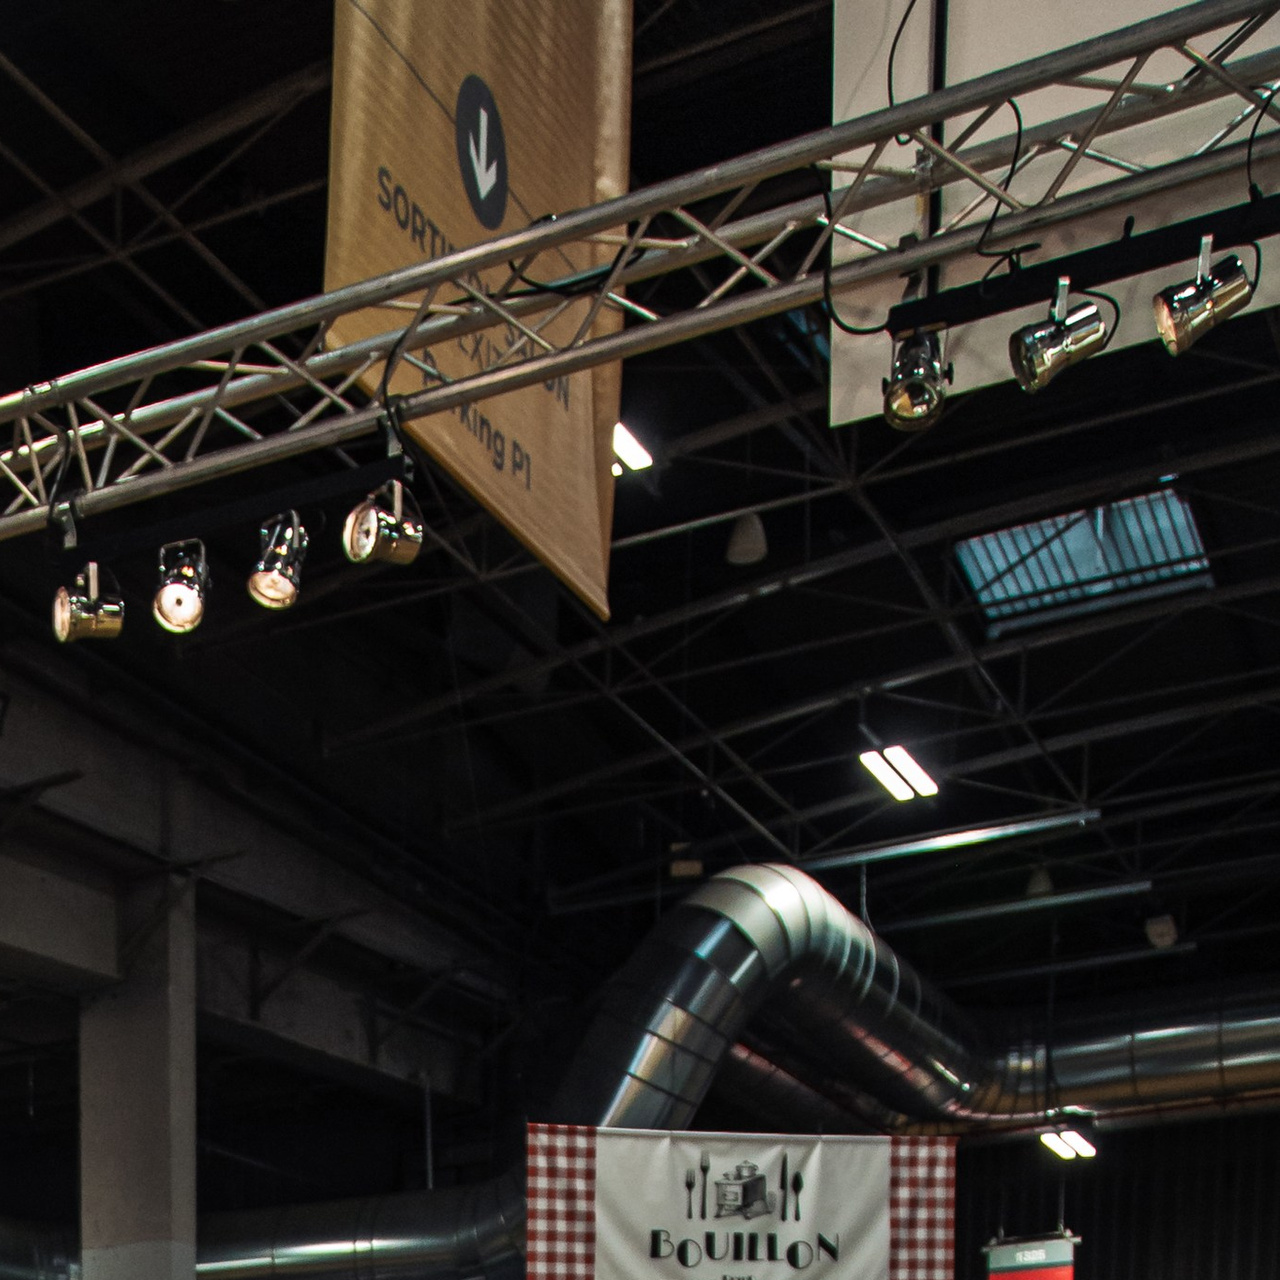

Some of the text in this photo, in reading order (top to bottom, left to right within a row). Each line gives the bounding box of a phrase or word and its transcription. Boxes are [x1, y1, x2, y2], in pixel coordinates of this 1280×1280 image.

[377, 165, 457, 259] SORTI
[423, 347, 532, 490] Pking P1
[650, 1228, 840, 1270] BOUILLON
